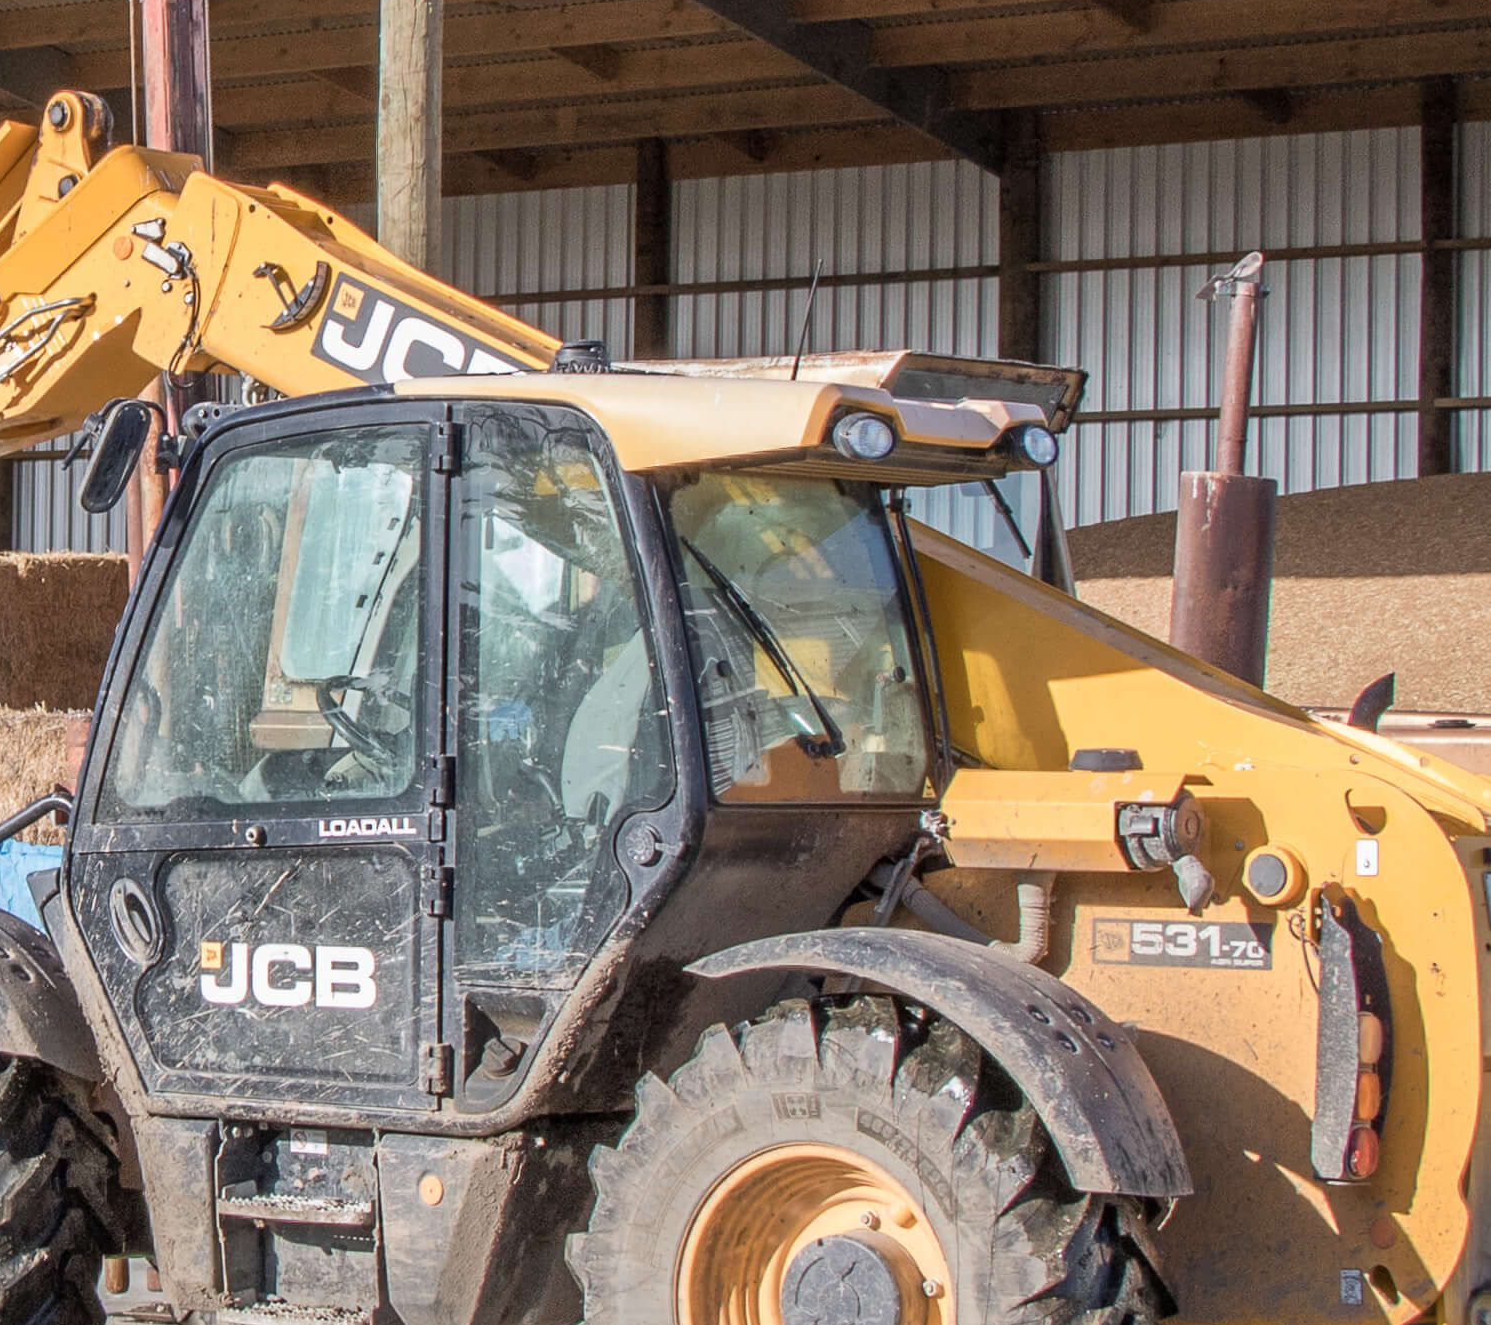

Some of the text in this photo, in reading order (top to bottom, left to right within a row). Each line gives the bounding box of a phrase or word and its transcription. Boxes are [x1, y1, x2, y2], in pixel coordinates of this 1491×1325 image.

[319, 817, 417, 837] LOADALL
[1131, 922, 1265, 959] 531-70
[200, 942, 377, 1010] JCB
